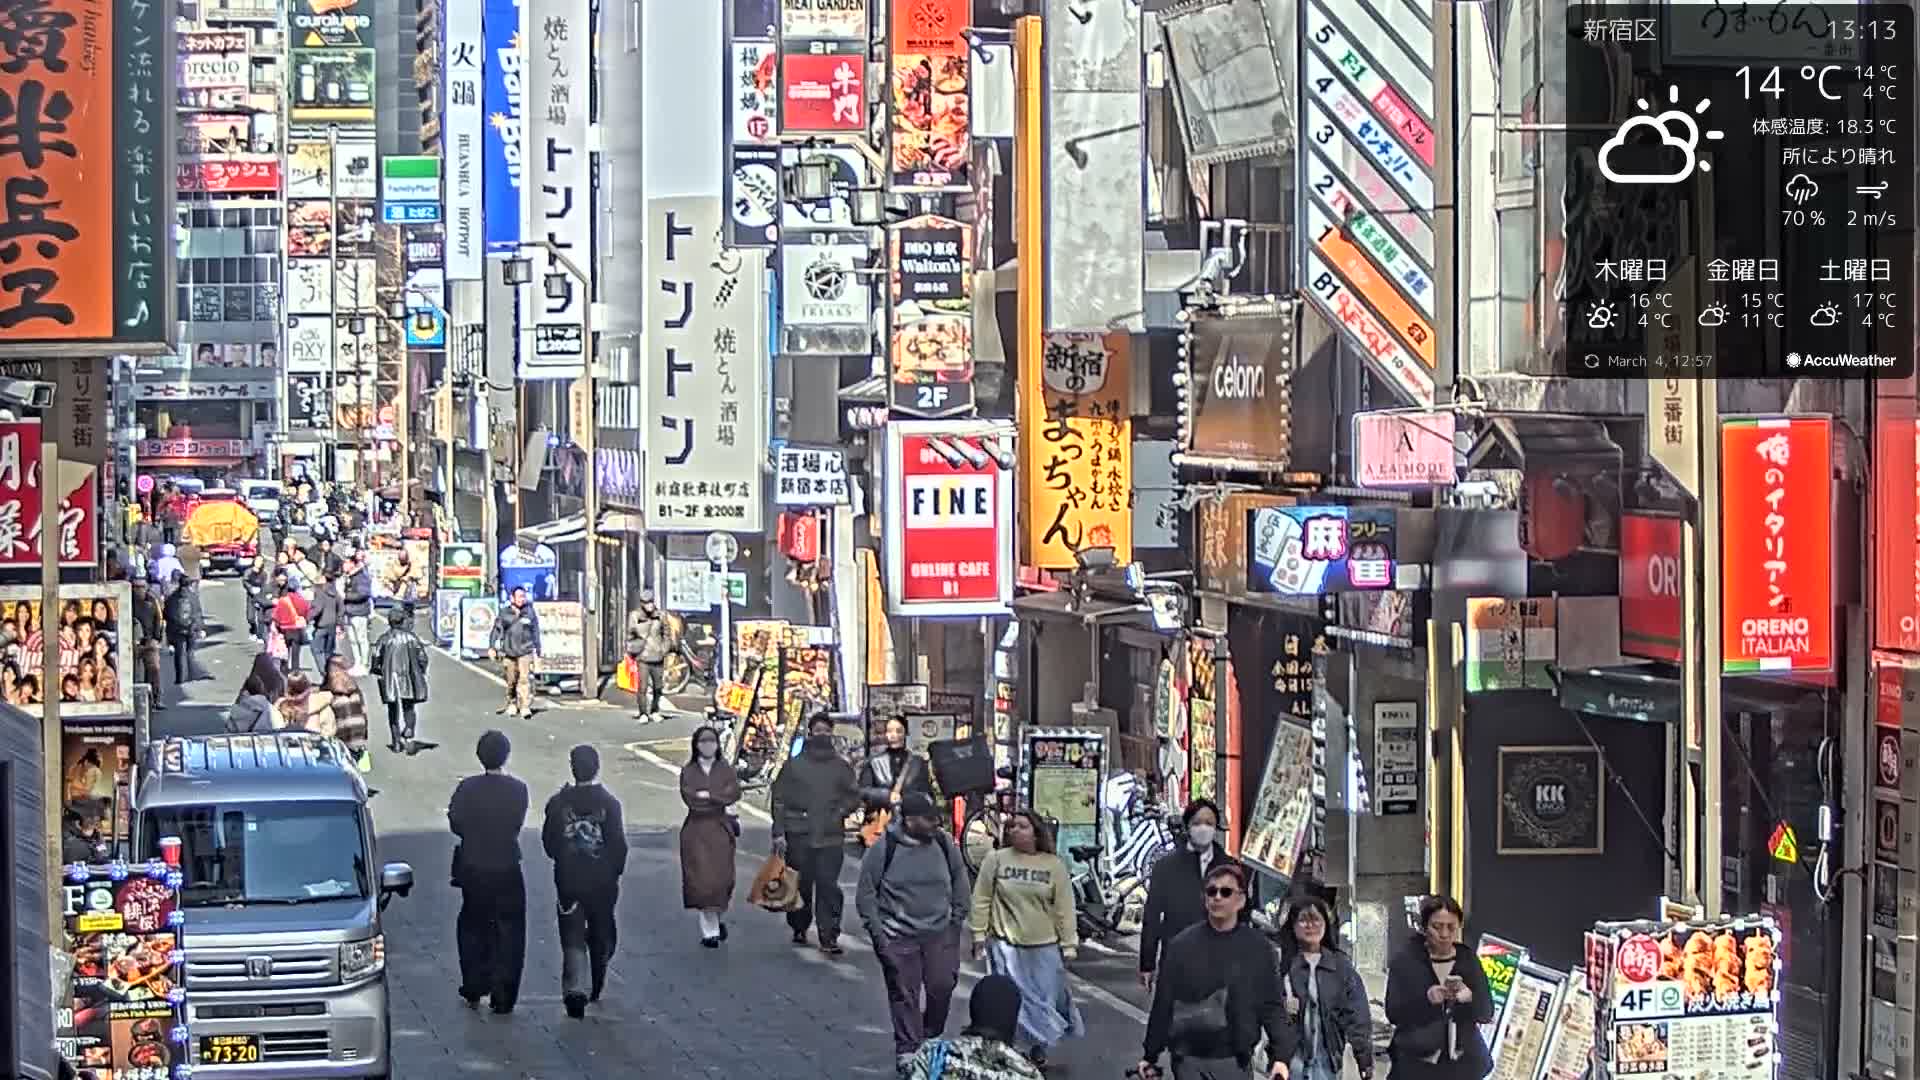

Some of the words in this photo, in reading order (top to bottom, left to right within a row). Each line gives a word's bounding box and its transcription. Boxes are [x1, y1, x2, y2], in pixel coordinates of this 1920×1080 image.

[819, 0, 863, 10] GARDEN
[186, 37, 245, 49] ネットカフェ
[1315, 23, 1336, 44] 5
[452, 41, 476, 106] 火鍋
[544, 16, 570, 126] 焼とん酒場
[1315, 77, 1335, 94] 4
[1315, 124, 1335, 144] 3
[1314, 175, 1335, 195] 2
[901, 257, 961, 274] Walton's
[1313, 272, 1340, 300] B1
[661, 211, 693, 465] トントン
[713, 327, 738, 447] 焼とん酒場
[1214, 355, 1265, 399] celona
[917, 386, 949, 408] 2F
[781, 452, 842, 473] 酒場心
[1043, 398, 1087, 552] まっちゃん
[655, 480, 750, 498] 新宿歌舞伎町店
[780, 477, 846, 496] 新宿本店
[912, 487, 988, 516] FINE
[1756, 432, 1791, 607] 俺のイタリアン
[911, 562, 956, 578] ONLINE
[958, 561, 991, 577] CAFE
[1741, 618, 1809, 636] ORENO
[1741, 637, 1809, 654] ITALIAN
[1535, 784, 1565, 802] KK
[1620, 989, 1653, 1011] 4F
